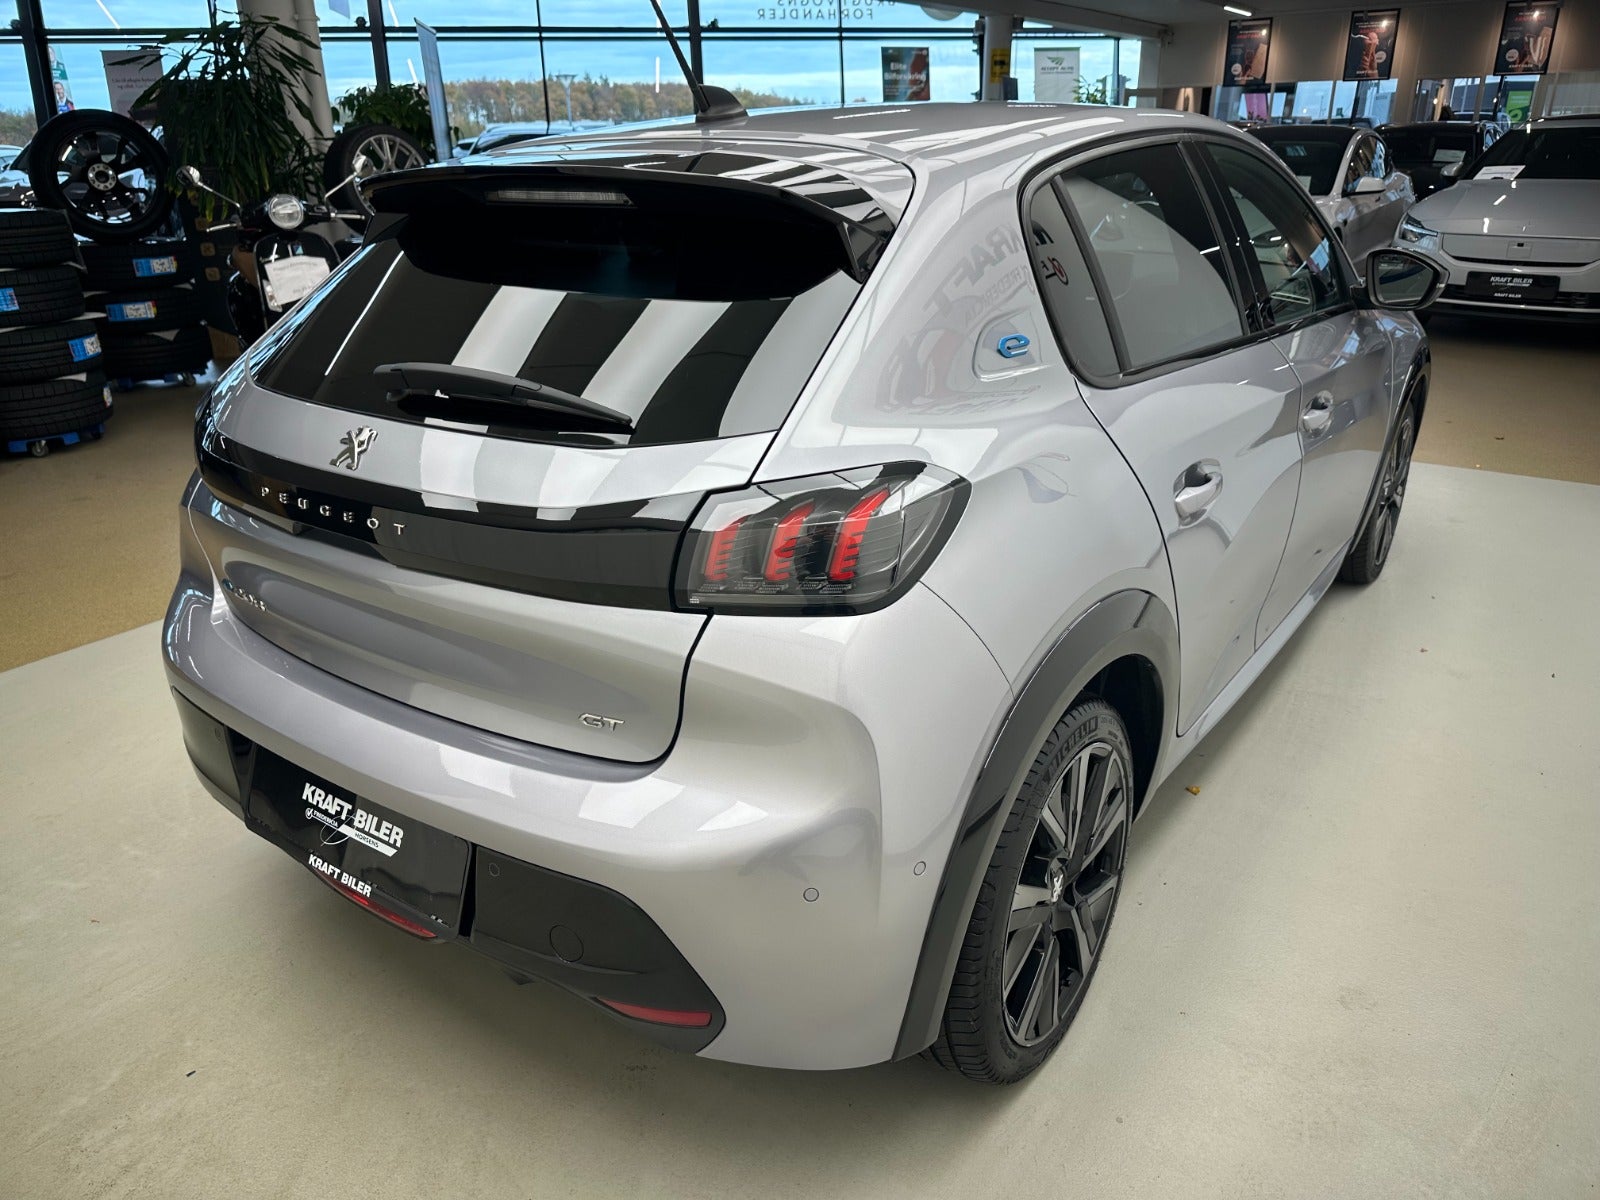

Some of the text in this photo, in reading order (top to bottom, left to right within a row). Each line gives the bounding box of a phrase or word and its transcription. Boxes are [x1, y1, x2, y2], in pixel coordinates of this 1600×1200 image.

[261, 486, 406, 535] PEUGEOT
[578, 713, 626, 731] GT
[302, 782, 404, 848] KRAFT BILER
[354, 832, 379, 848] HORSENS
[308, 853, 372, 897] KRAFT BILER
